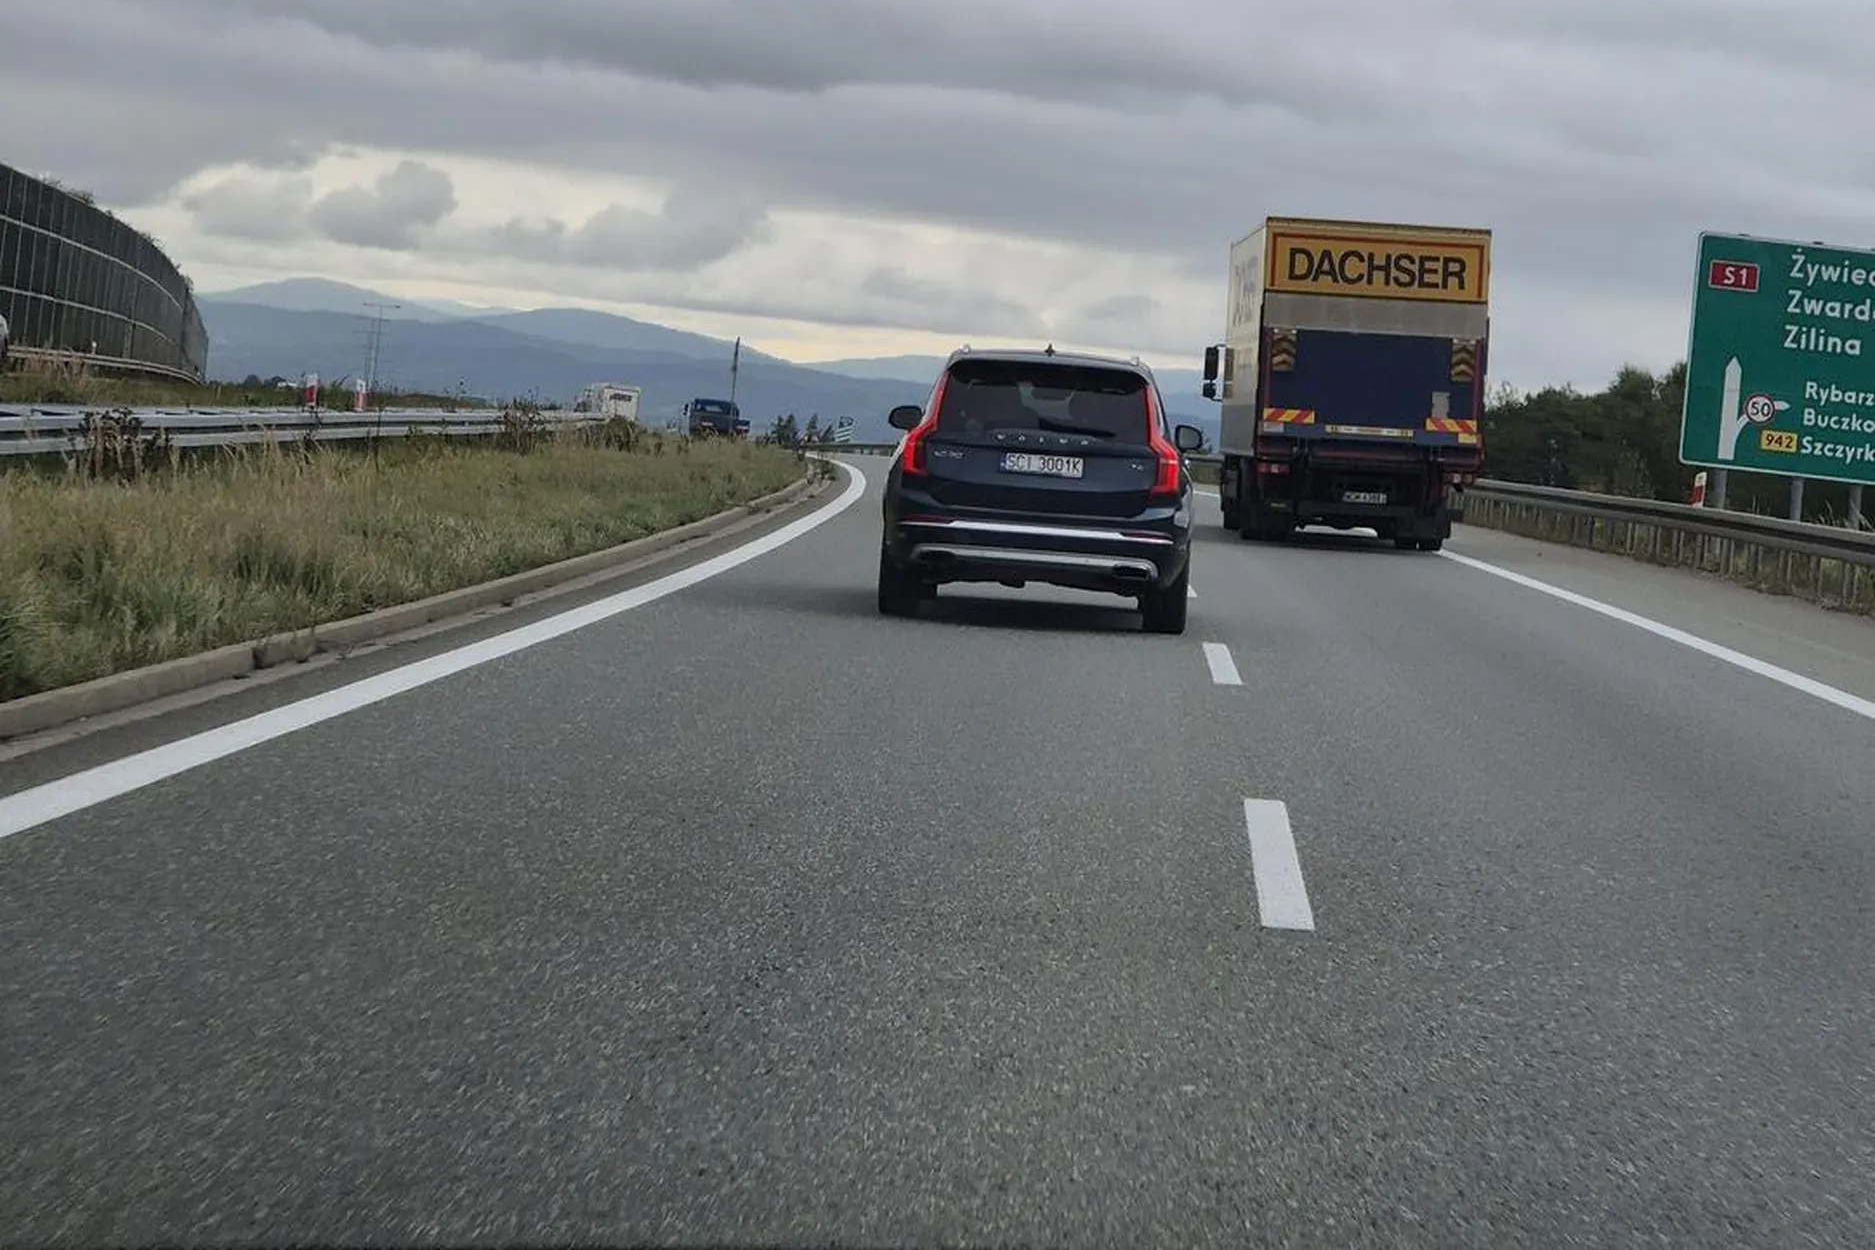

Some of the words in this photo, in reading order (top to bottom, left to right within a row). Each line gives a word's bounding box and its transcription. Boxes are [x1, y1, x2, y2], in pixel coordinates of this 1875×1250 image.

[1288, 247, 1466, 290] DACHSER
[1723, 266, 1748, 286] S1
[1786, 289, 1875, 322] Zward
[1783, 324, 1862, 357] Zilina
[1804, 380, 1875, 407] Rybarz
[1750, 401, 1772, 417] 50
[1803, 407, 1875, 434] Buczko
[1765, 434, 1794, 449] 942
[1801, 435, 1875, 465] Szczyrk
